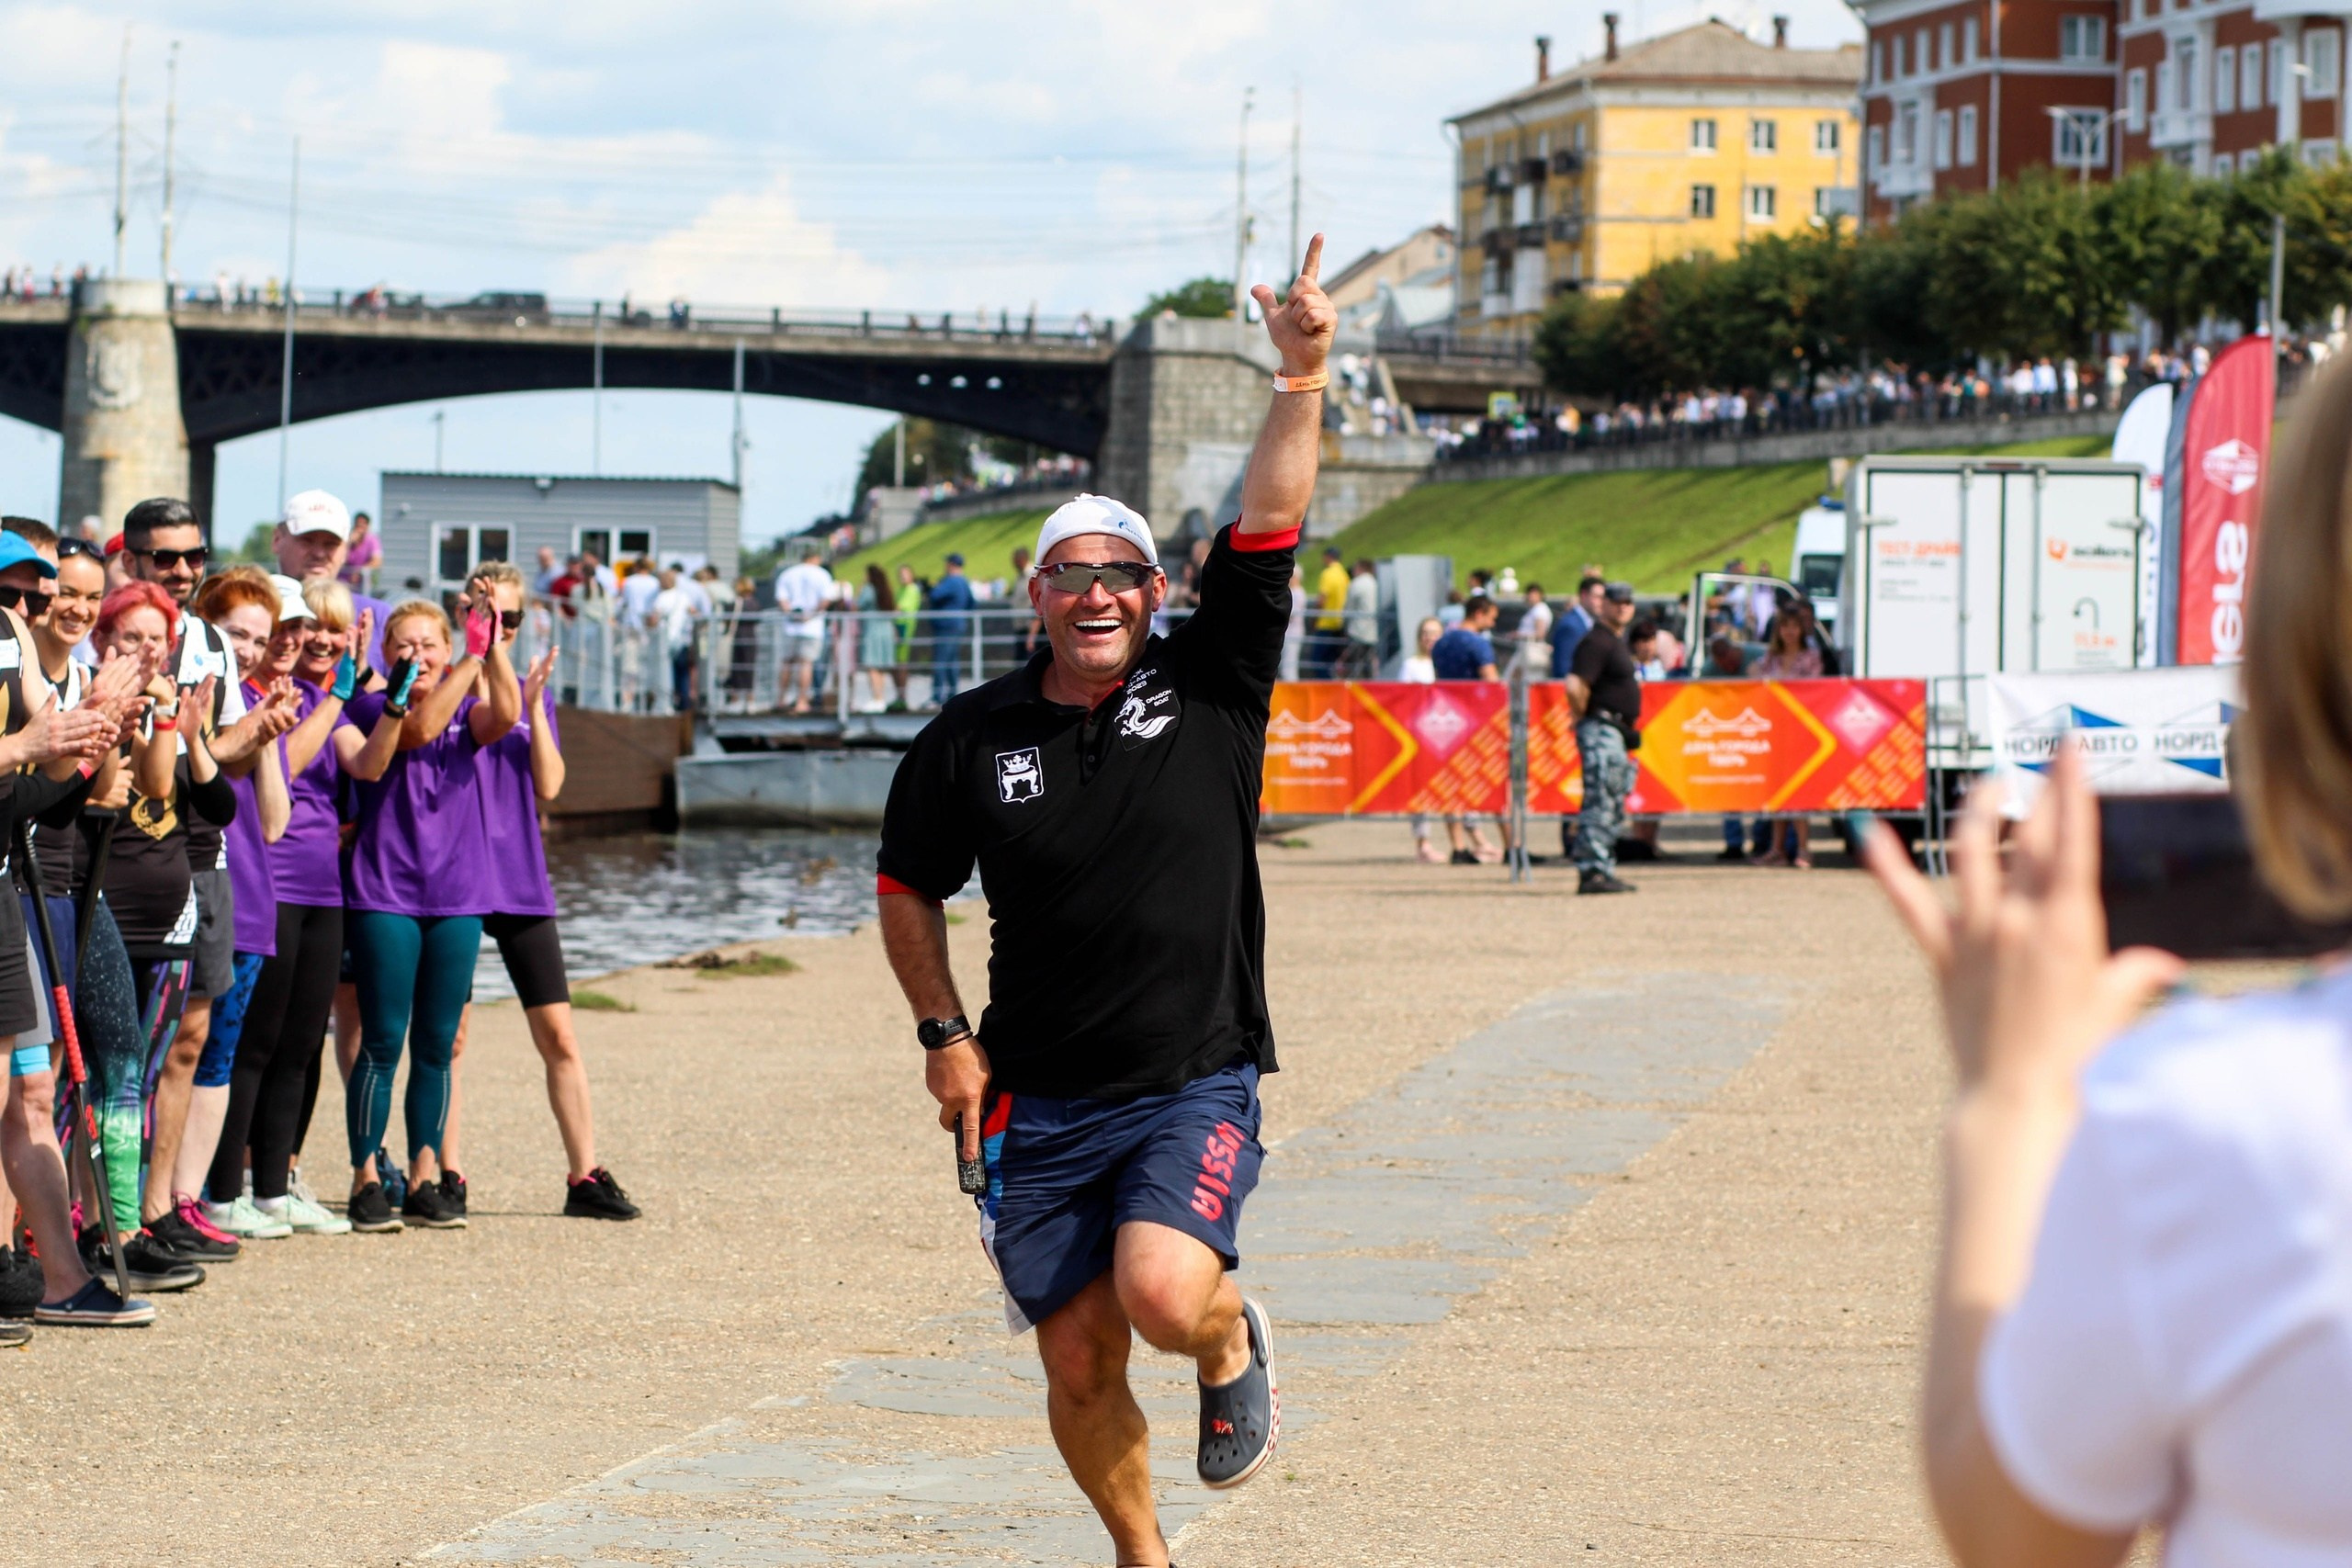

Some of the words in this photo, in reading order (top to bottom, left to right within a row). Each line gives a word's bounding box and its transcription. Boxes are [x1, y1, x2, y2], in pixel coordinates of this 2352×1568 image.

[1126, 680, 1148, 695] 2023
[1145, 689, 1172, 705] DRAGON
[1153, 695, 1170, 707] BOAT
[1191, 1120, 1246, 1222] USSIA
